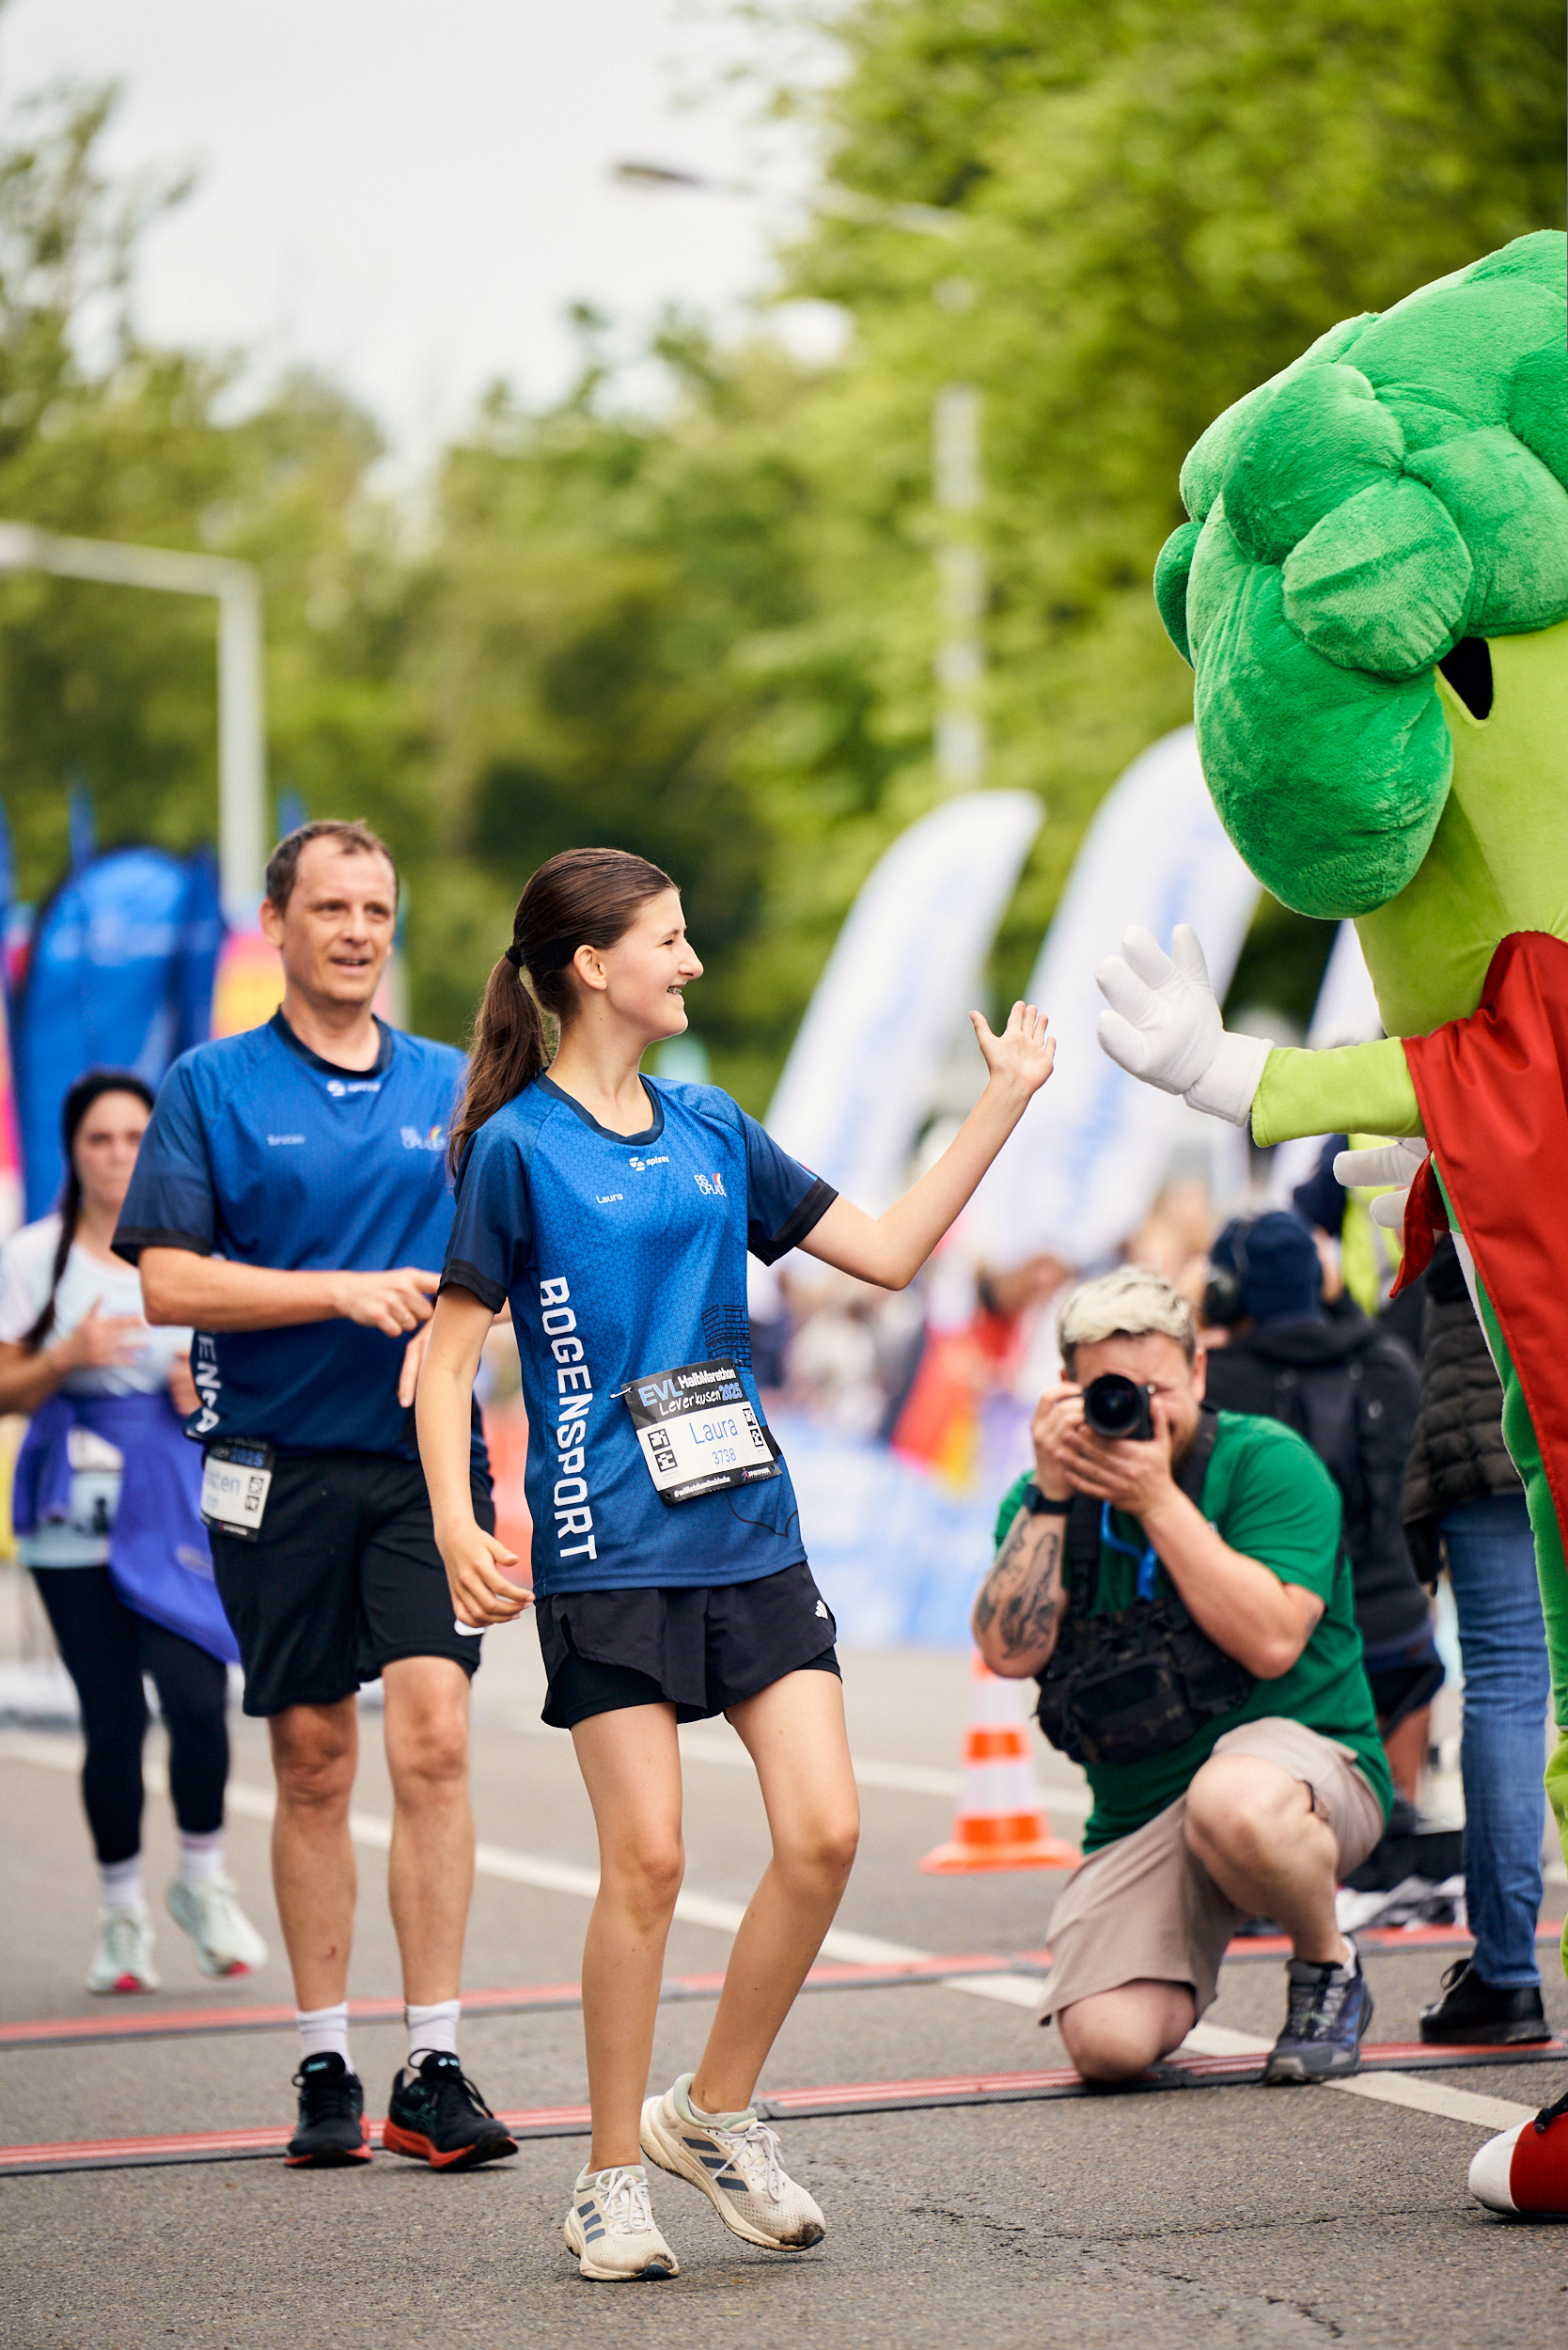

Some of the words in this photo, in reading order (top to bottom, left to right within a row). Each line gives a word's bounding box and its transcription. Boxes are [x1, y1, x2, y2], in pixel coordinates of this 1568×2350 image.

[596, 1193, 623, 1204] Laura
[638, 1378, 683, 1407] EVL
[677, 1367, 737, 1389] HalbMarathon
[659, 1389, 721, 1416] Leverkusen
[718, 1382, 743, 1401] 2025
[540, 1277, 597, 1559] BOGENSPORT
[689, 1418, 738, 1444] Laura
[712, 1448, 737, 1465] 3738
